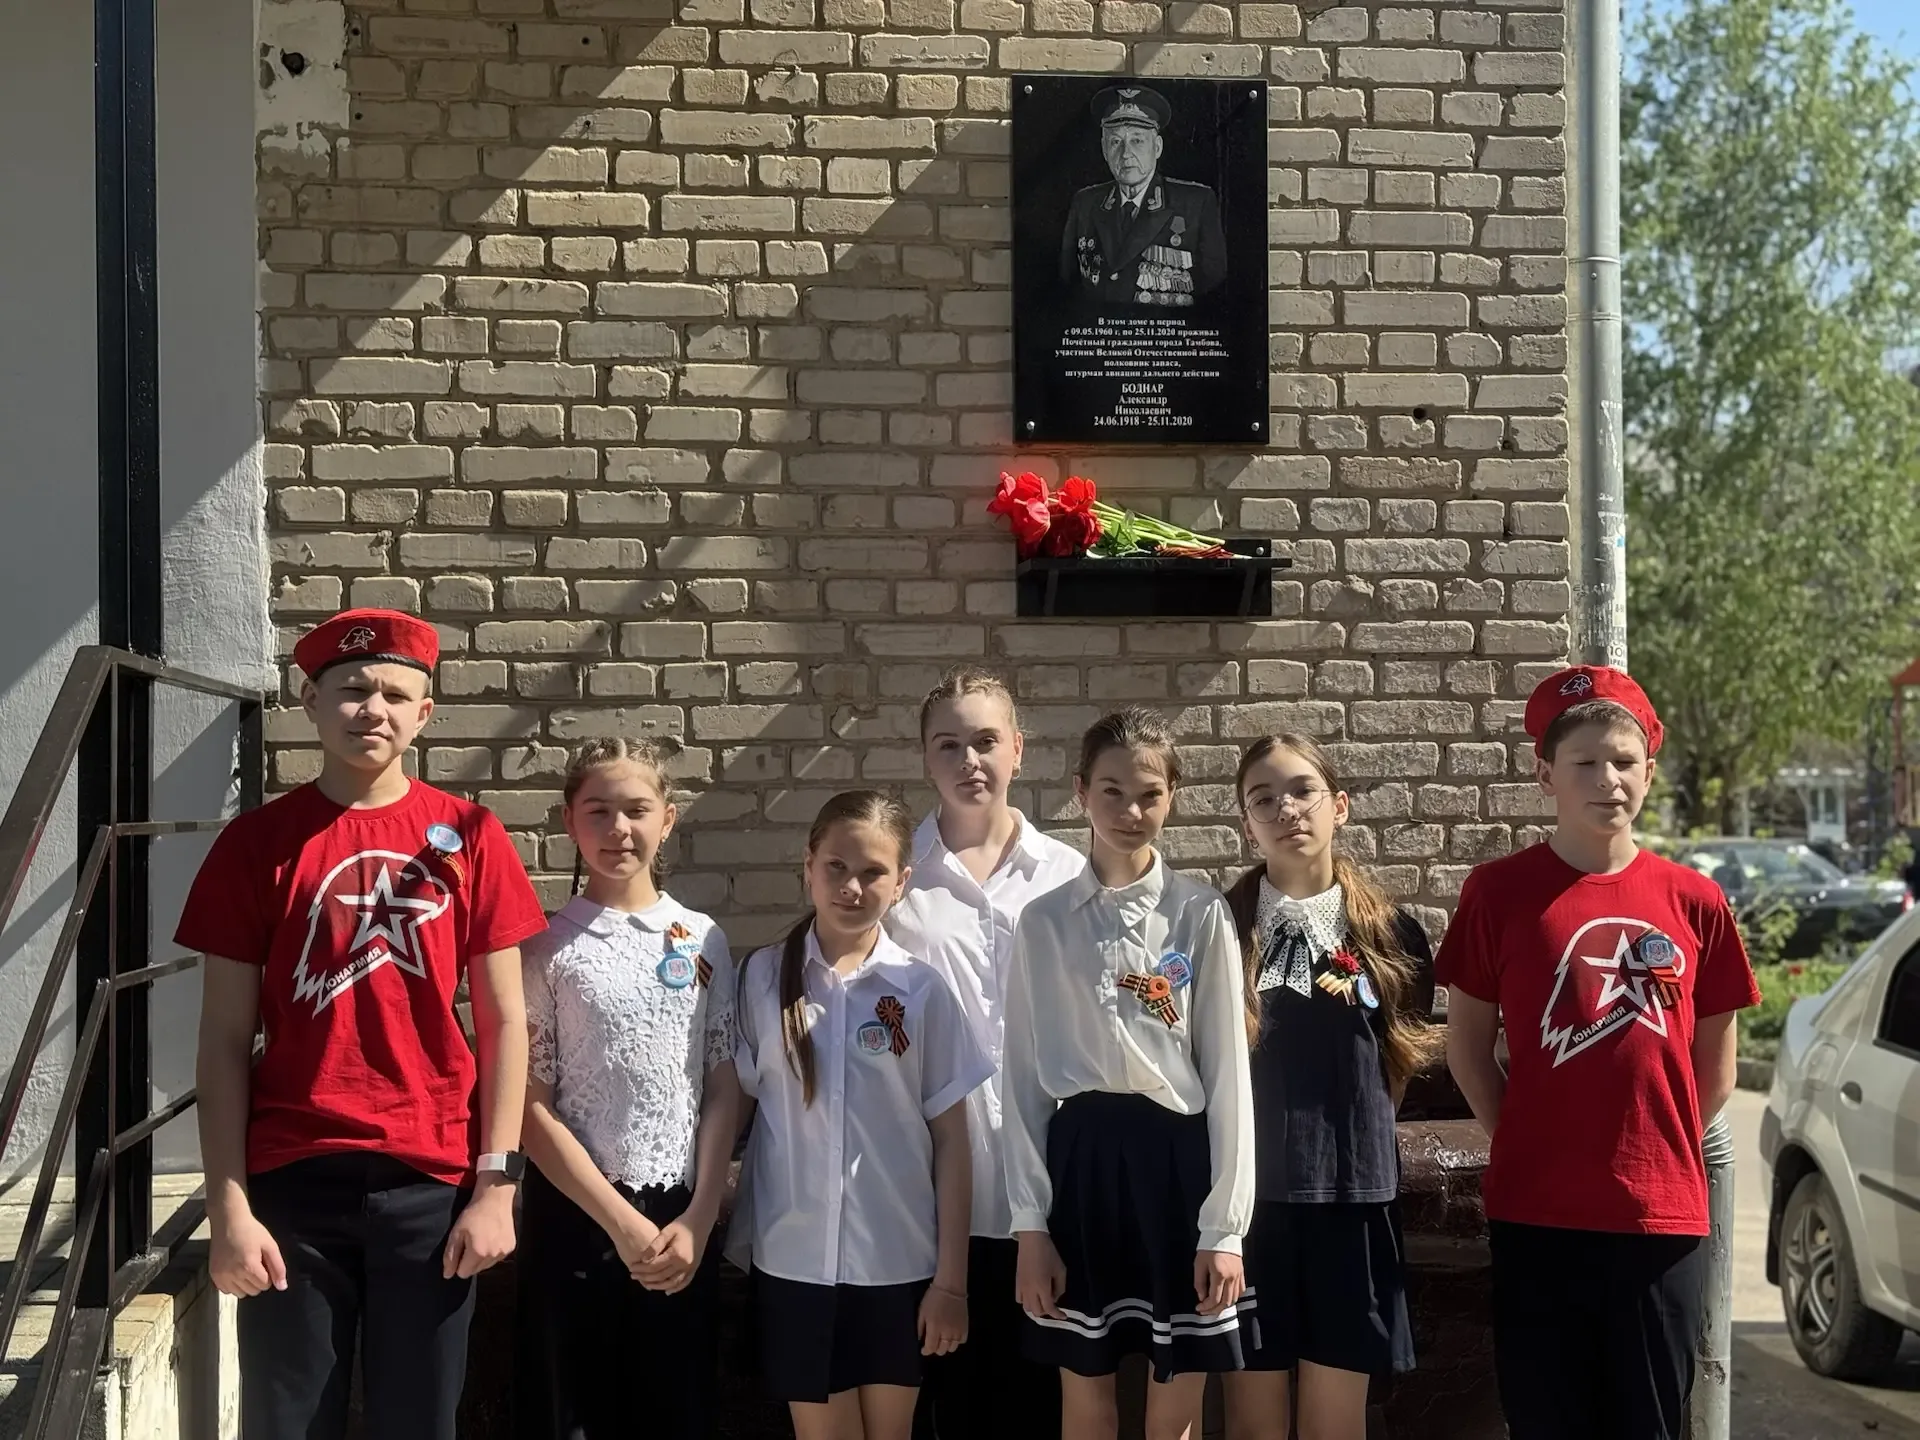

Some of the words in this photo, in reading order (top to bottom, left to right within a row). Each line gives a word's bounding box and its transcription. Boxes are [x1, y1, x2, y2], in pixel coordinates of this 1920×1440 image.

[1098, 317, 1105, 326] В
[1156, 319, 1186, 327] период
[1070, 327, 1113, 336] 09.05.1960
[1134, 328, 1176, 336] 25.11.2020
[1177, 330, 1219, 338] проживал
[1107, 339, 1153, 348] гражданин
[1155, 340, 1183, 348] города
[1184, 338, 1223, 348] Тамбова,
[1055, 349, 1095, 358] участник
[1096, 348, 1133, 357] Великой
[1134, 348, 1198, 357] Отечественной
[1199, 349, 1230, 358] войны,
[1152, 360, 1182, 368] запаса,
[1065, 370, 1104, 378] штурман
[1142, 370, 1181, 378] дальнего
[1182, 369, 1220, 378] действия
[1121, 383, 1164, 394] БОДНАР
[1118, 394, 1168, 406] Александр
[1115, 405, 1172, 415] Николаевич
[1094, 416, 1140, 426] 24.06.1918
[1147, 416, 1193, 426] 25.11.2020
[325, 946, 382, 991] ЮНАРМИЯ
[1572, 1005, 1627, 1044] ЮНАРМИЯ
